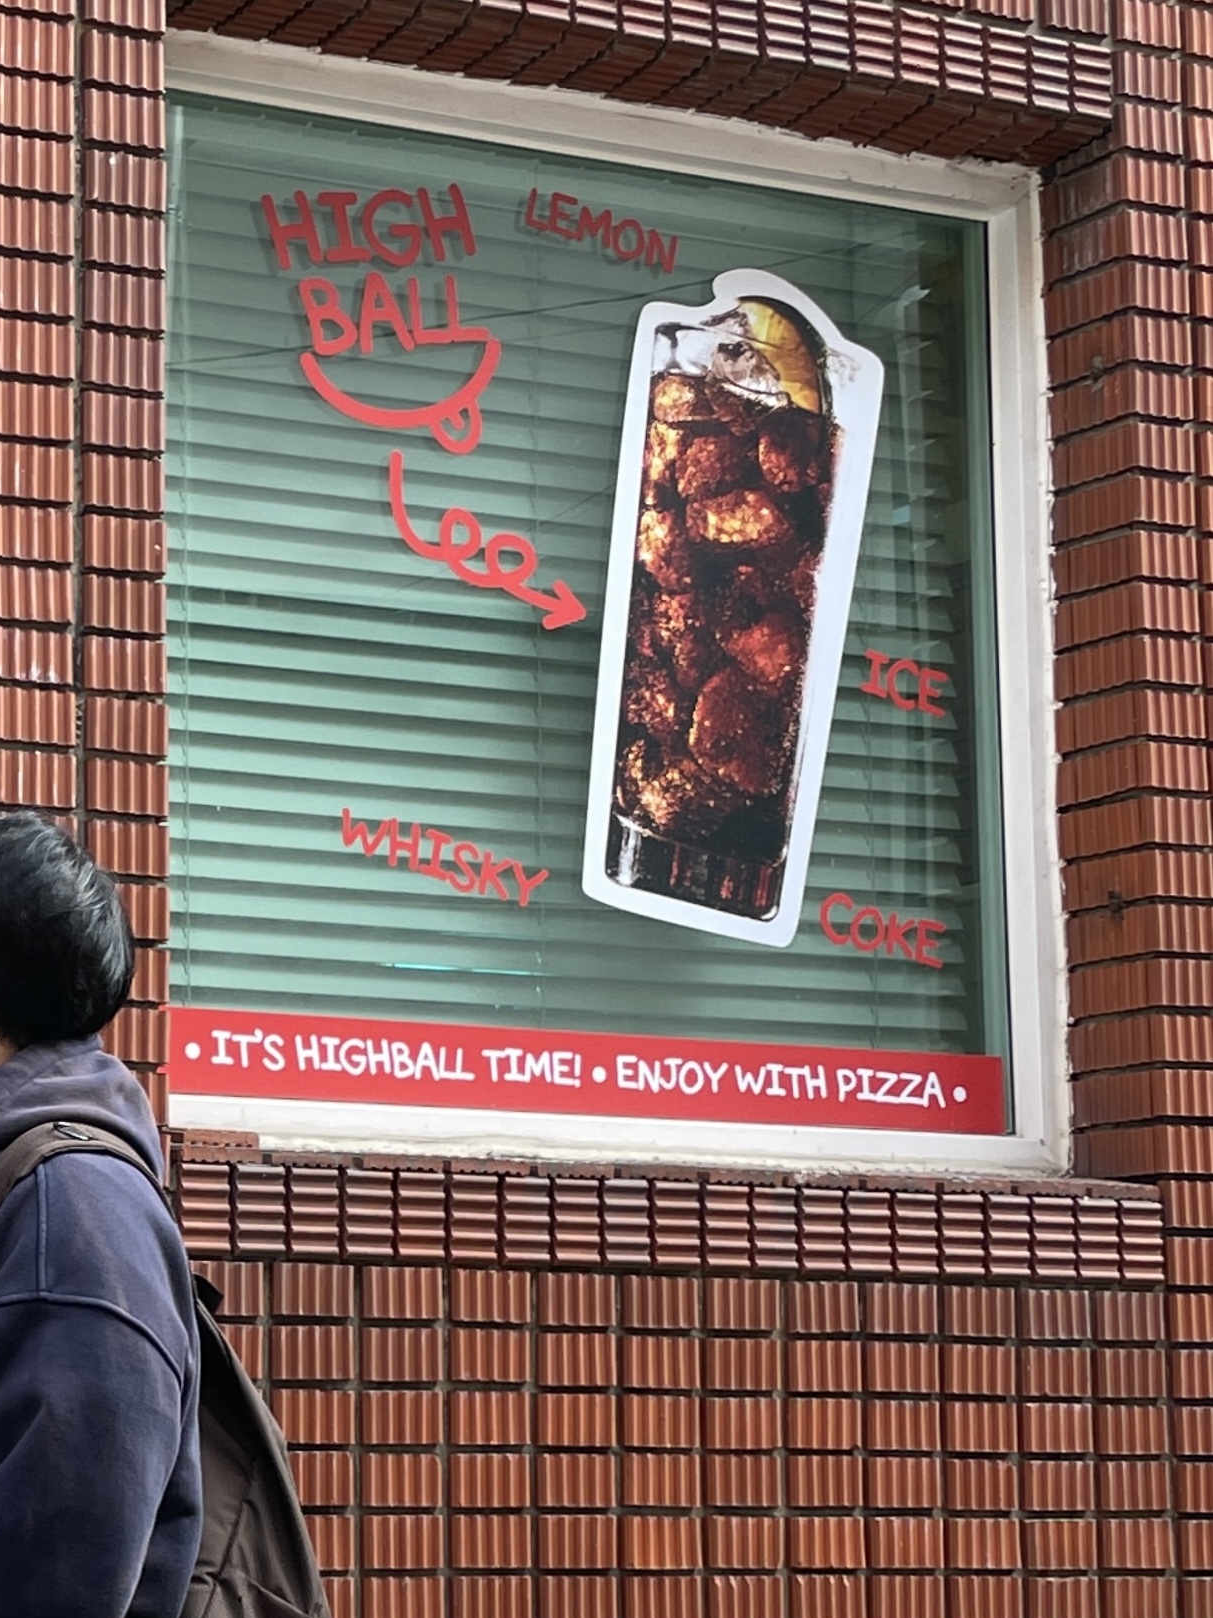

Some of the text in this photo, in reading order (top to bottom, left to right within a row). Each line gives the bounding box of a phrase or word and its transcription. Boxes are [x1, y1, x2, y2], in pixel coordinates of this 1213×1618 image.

[261, 182, 477, 271] HIGH
[525, 187, 679, 275] LEMON
[298, 271, 491, 356] BALL
[859, 648, 950, 718] ICE
[340, 807, 549, 908] WHISKY
[819, 891, 947, 969] COKE
[210, 1029, 947, 1109] IT'S HIGHBALL TIME! ENJOY WITH PIZZA
